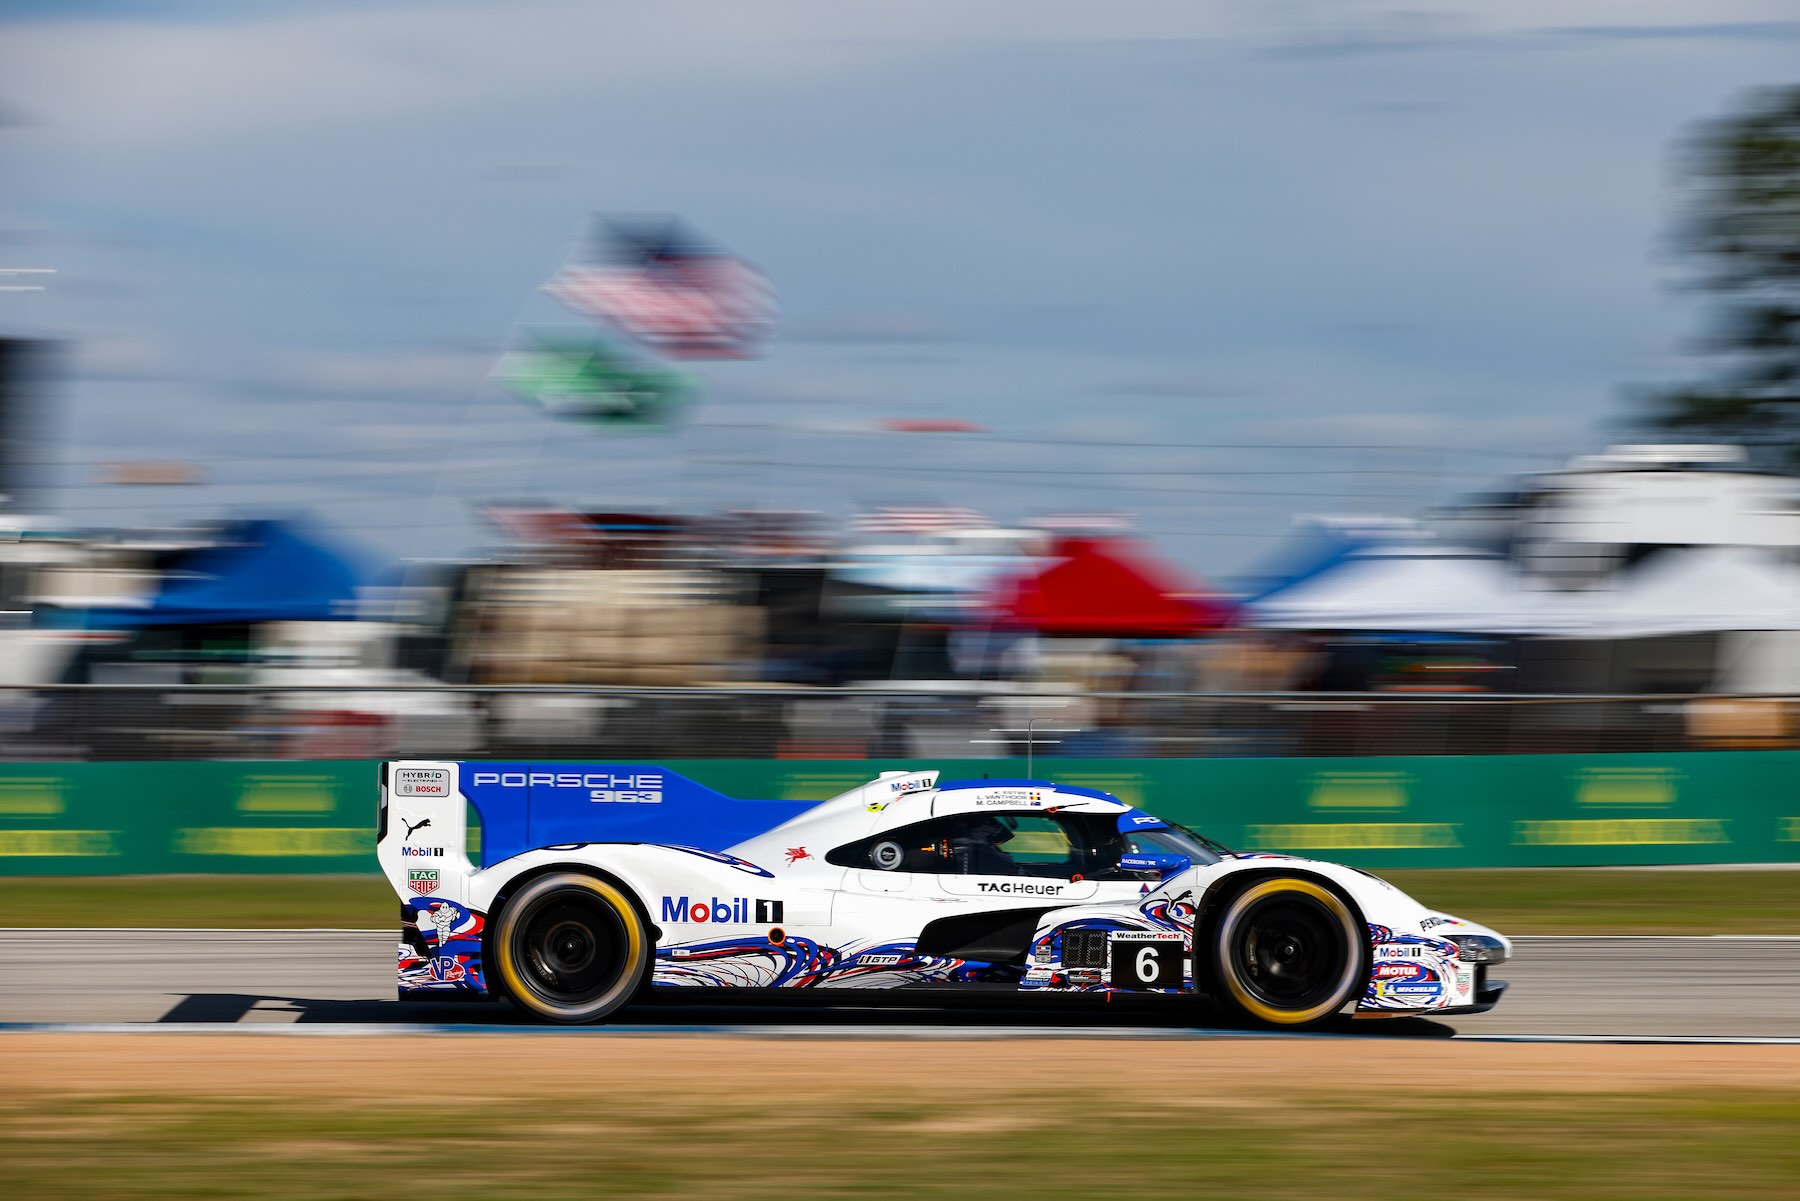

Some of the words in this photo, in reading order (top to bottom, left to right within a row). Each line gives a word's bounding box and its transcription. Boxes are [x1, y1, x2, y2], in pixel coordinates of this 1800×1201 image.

[402, 771, 442, 779] HYBRID
[473, 772, 663, 789] PORSCHE
[415, 785, 442, 793] BOSCH
[891, 780, 921, 792] Mobil
[590, 790, 663, 804] 963
[401, 847, 432, 857] Mobil
[411, 871, 438, 880] TAG
[409, 881, 439, 895] HEUER
[662, 896, 748, 923] Mobil
[1116, 932, 1180, 940] WeatherTech
[1379, 947, 1410, 957] Mobil
[430, 956, 455, 981] VP
[1135, 946, 1160, 983] 6
[1379, 967, 1419, 976] MOTUL
